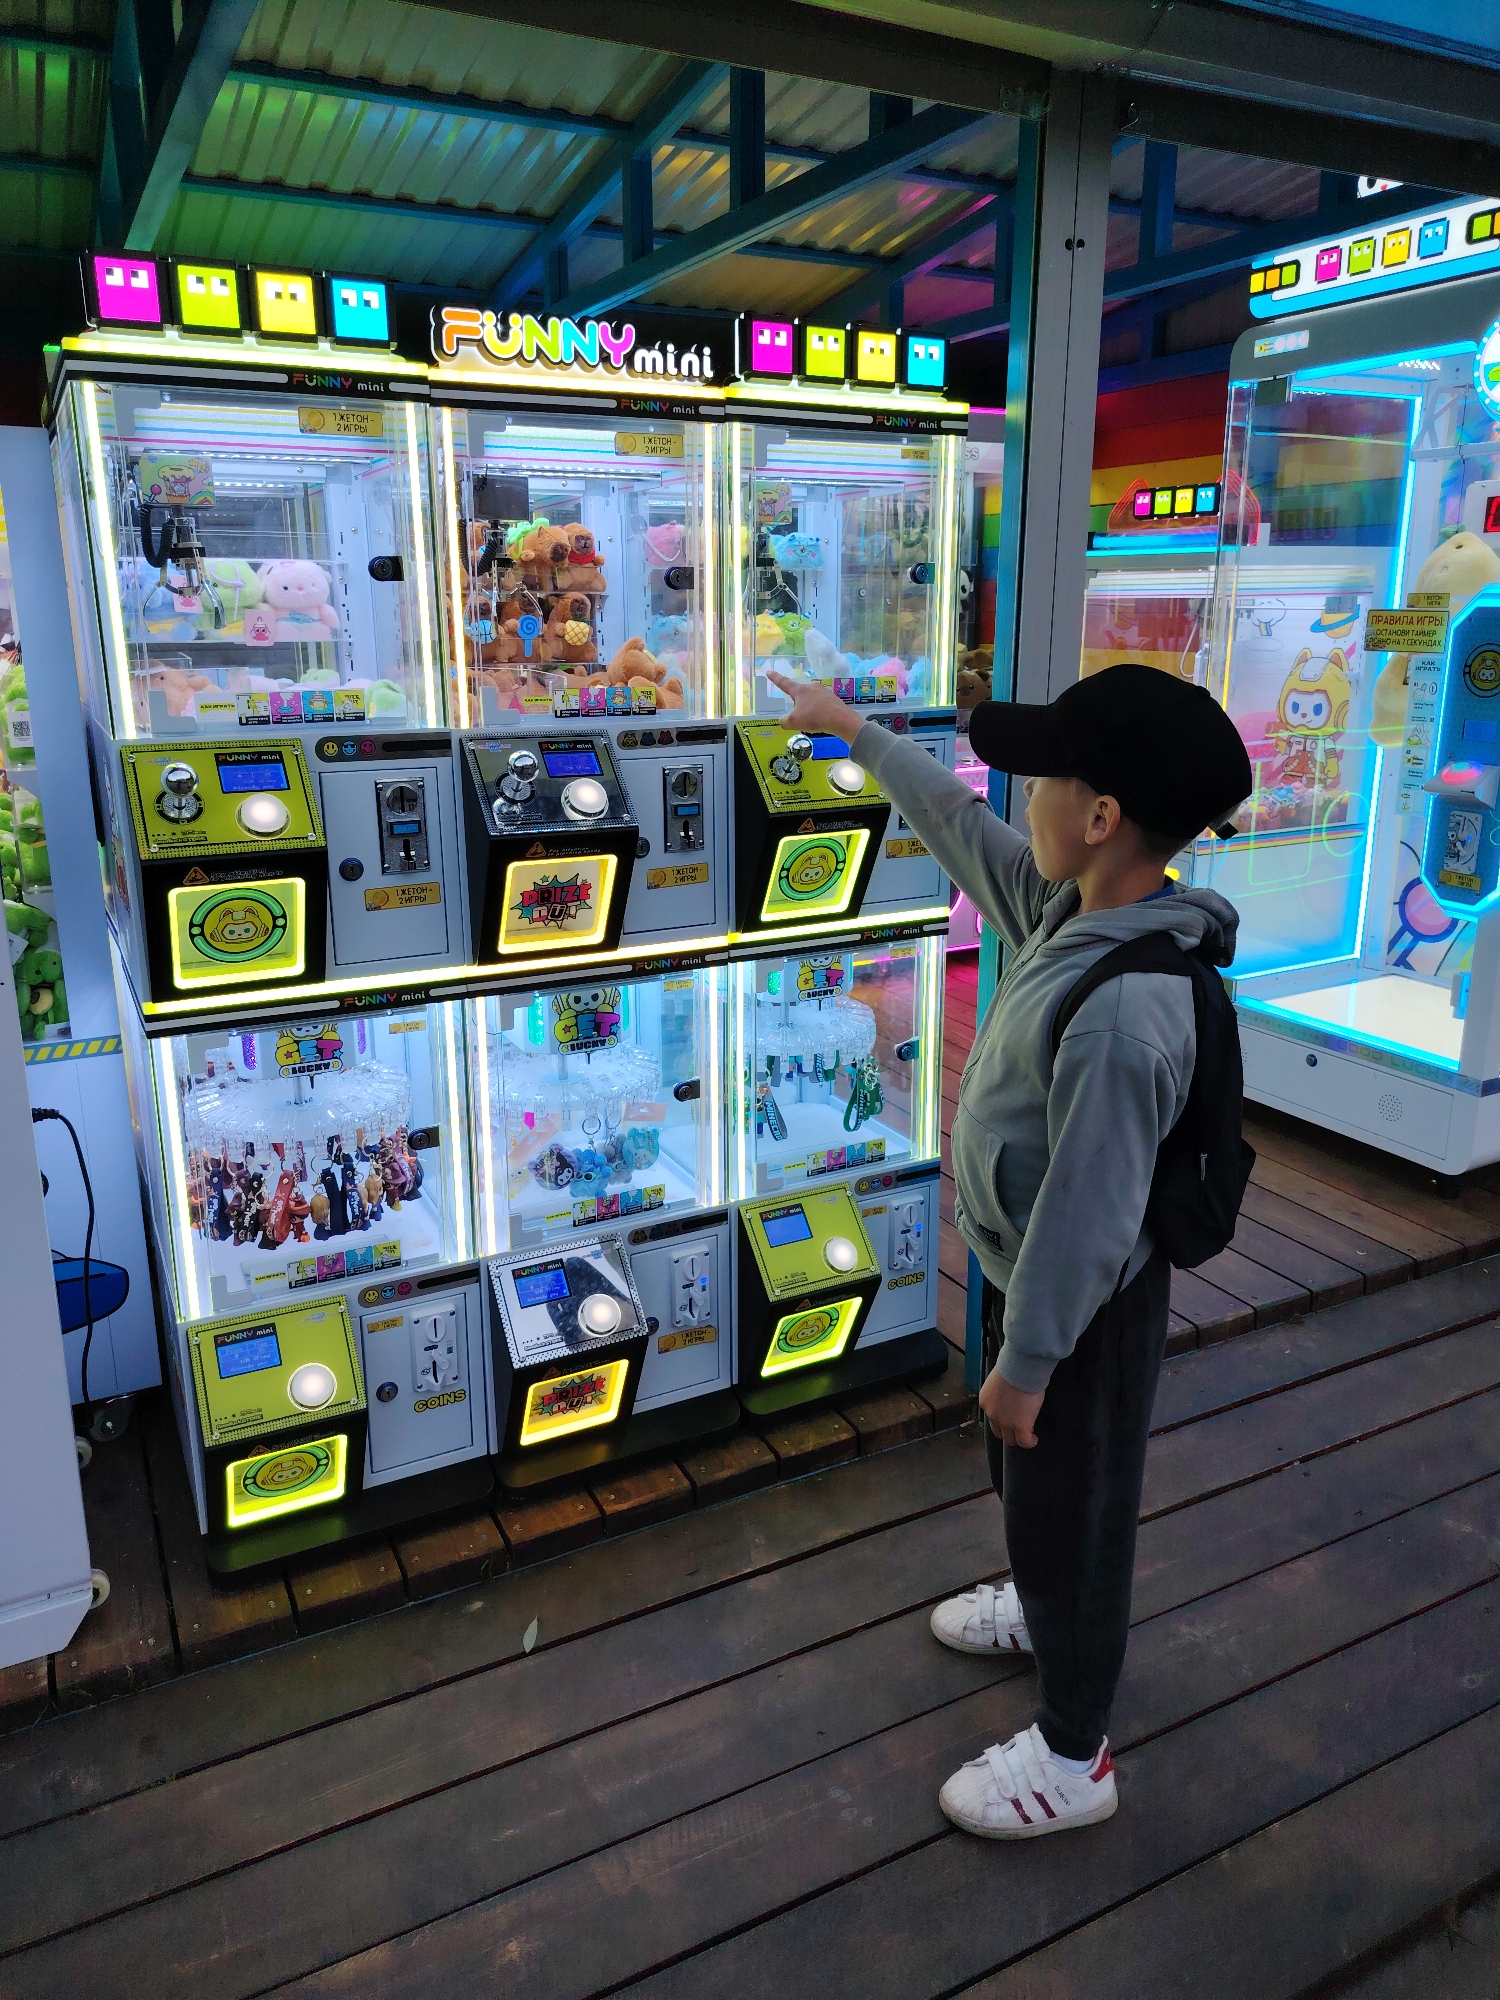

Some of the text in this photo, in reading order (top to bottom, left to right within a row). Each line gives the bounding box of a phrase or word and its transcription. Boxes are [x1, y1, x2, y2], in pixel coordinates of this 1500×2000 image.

[634, 343, 714, 378] mini
[357, 381, 385, 392] mini
[673, 405, 695, 415] mini
[333, 413, 337, 421] 1
[339, 413, 369, 423] ЖЕТОН
[337, 423, 368, 433] 2 ИГРЫ
[919, 420, 938, 429] mini
[647, 437, 671, 445] ЖЕТОН
[645, 445, 671, 454] 2 ИГРЫ
[1371, 615, 1445, 627] ПРАВИЛА ИГРЫ:
[1411, 628, 1437, 638] ТАЙМЕР
[1392, 638, 1400, 646] НА
[1406, 639, 1442, 647] СЕКУНДАХ
[676, 868, 699, 877] ЖЕТОН
[680, 874, 697, 883] ИГРЫ
[400, 887, 427, 897] ЖЕТОН
[522, 882, 592, 908] PRIZE
[398, 895, 427, 905] 2 ИГРЫ
[532, 901, 581, 923] OUT
[903, 926, 920, 935] mini
[682, 956, 702, 966] mini
[797, 968, 844, 991] GET
[401, 990, 426, 1001] mini
[806, 988, 835, 999] LUCKY
[554, 1012, 621, 1044] GET
[570, 1038, 607, 1051] LUCKY
[275, 1038, 343, 1067] GET
[291, 1062, 332, 1075] LUCKY
[547, 1261, 562, 1270] mini
[887, 1272, 926, 1290] COINS
[256, 1327, 274, 1336] mini
[685, 1329, 707, 1338] ЖЕТОН
[543, 1377, 606, 1407] PRIZE
[413, 1389, 466, 1413] COINS
